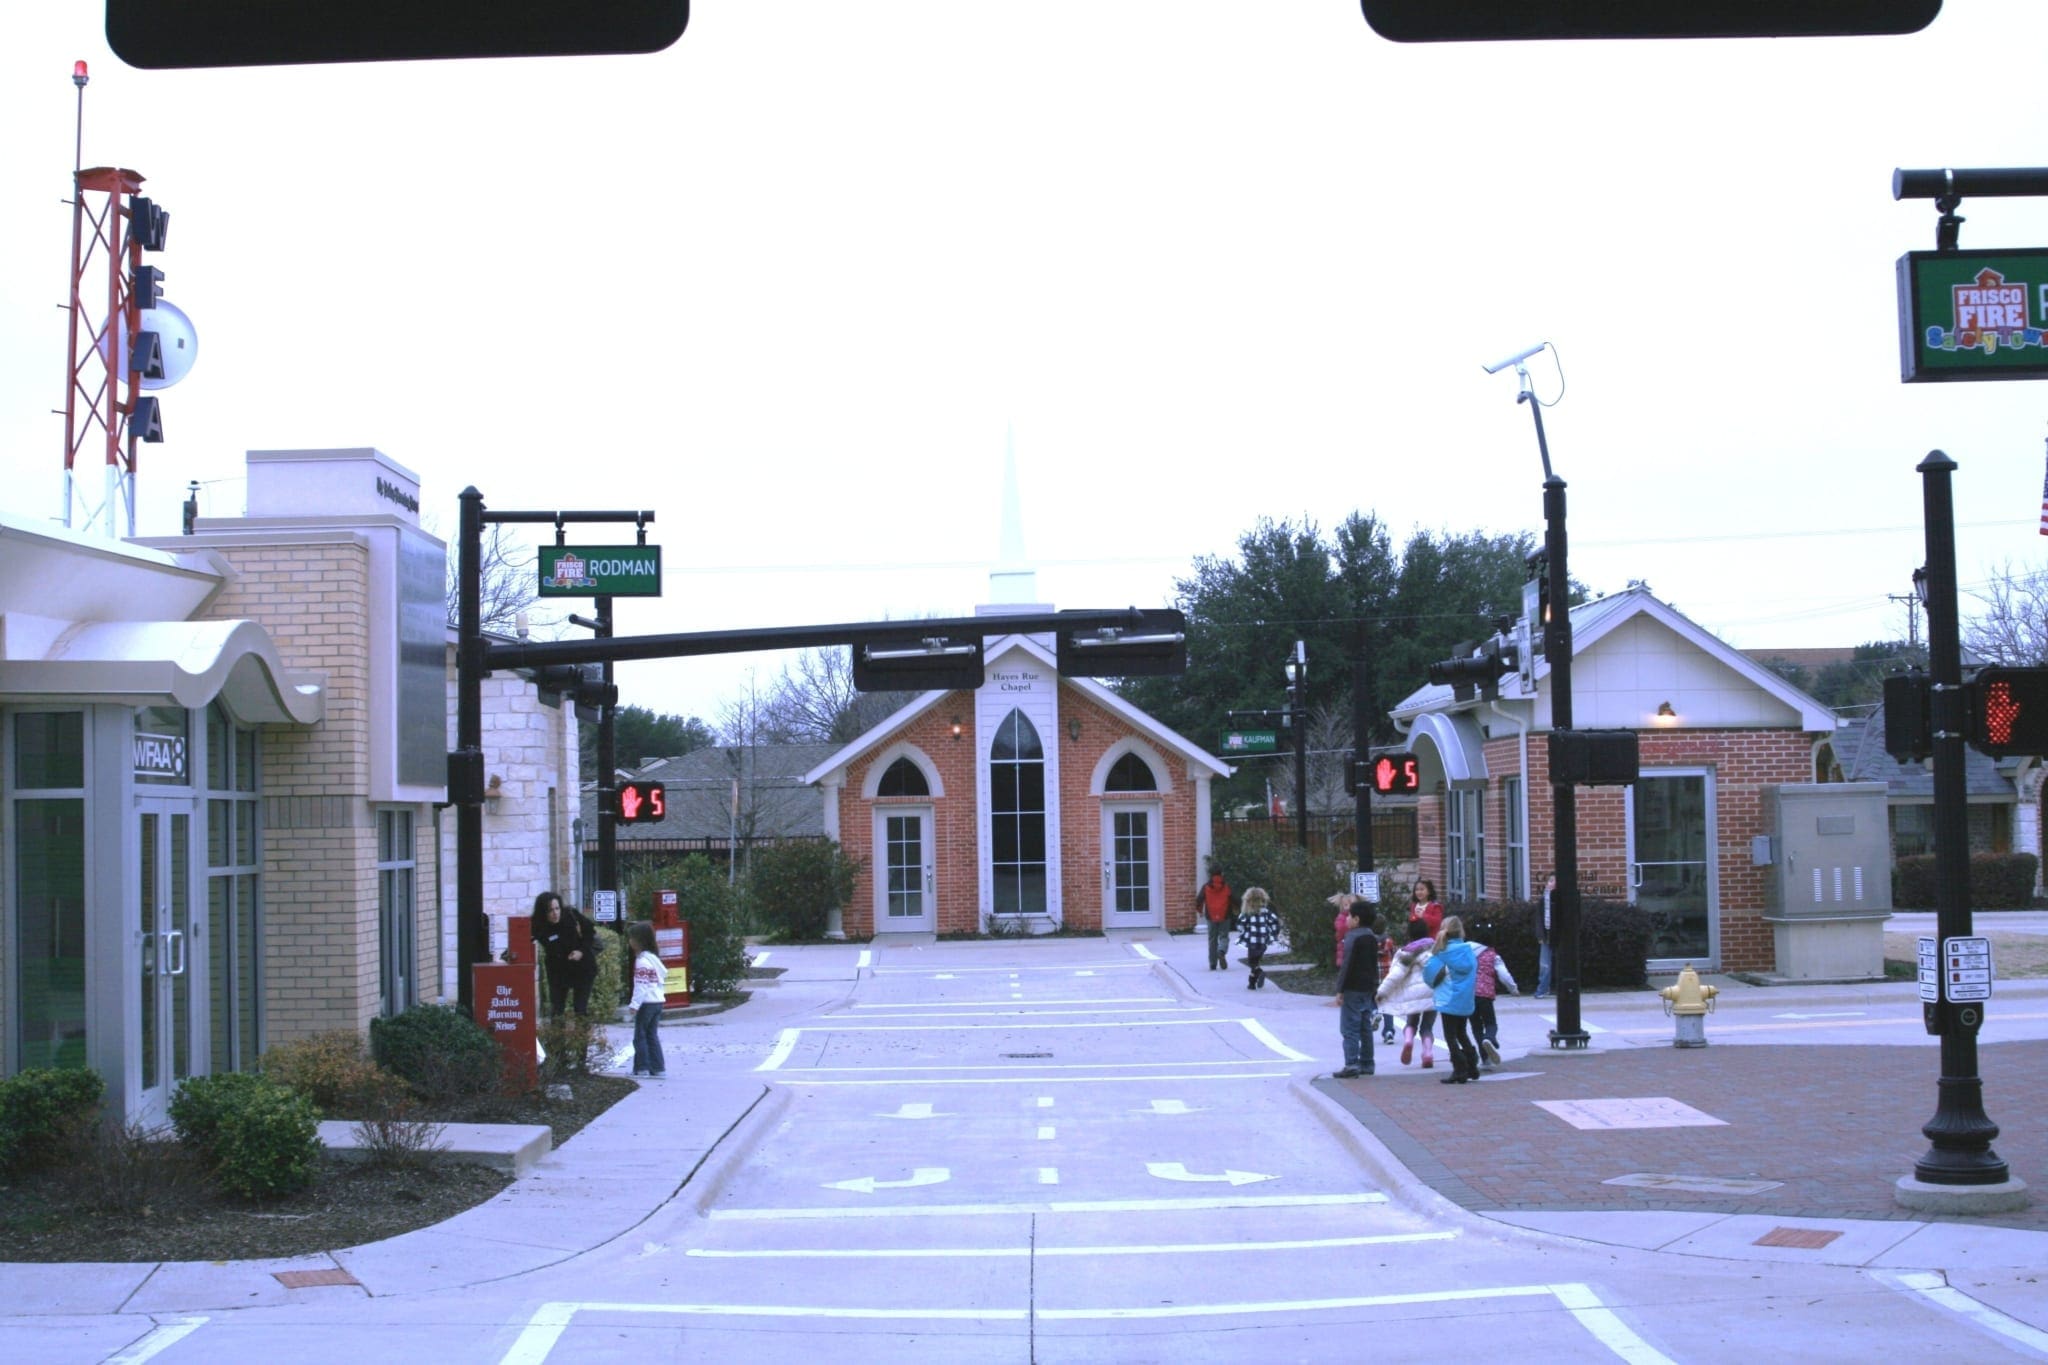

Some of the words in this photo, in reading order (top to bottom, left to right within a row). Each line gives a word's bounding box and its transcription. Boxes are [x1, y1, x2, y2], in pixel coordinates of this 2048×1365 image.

[1958, 289, 2022, 304] FRISCO
[1959, 305, 2023, 328] FIRE
[557, 561, 583, 569] FRISCO
[590, 560, 655, 576] RODMAN
[557, 568, 583, 578] FIRE
[1001, 683, 1031, 691] Chapel
[1244, 735, 1275, 745] KAUFMAN
[133, 740, 172, 769] WFAA
[1404, 760, 1418, 788] 5
[651, 789, 663, 815] 5
[1585, 884, 1623, 894] Center
[496, 985, 513, 997] The
[491, 997, 519, 1008] Dallas
[487, 1009, 523, 1020] Morning
[494, 1021, 517, 1031] News
